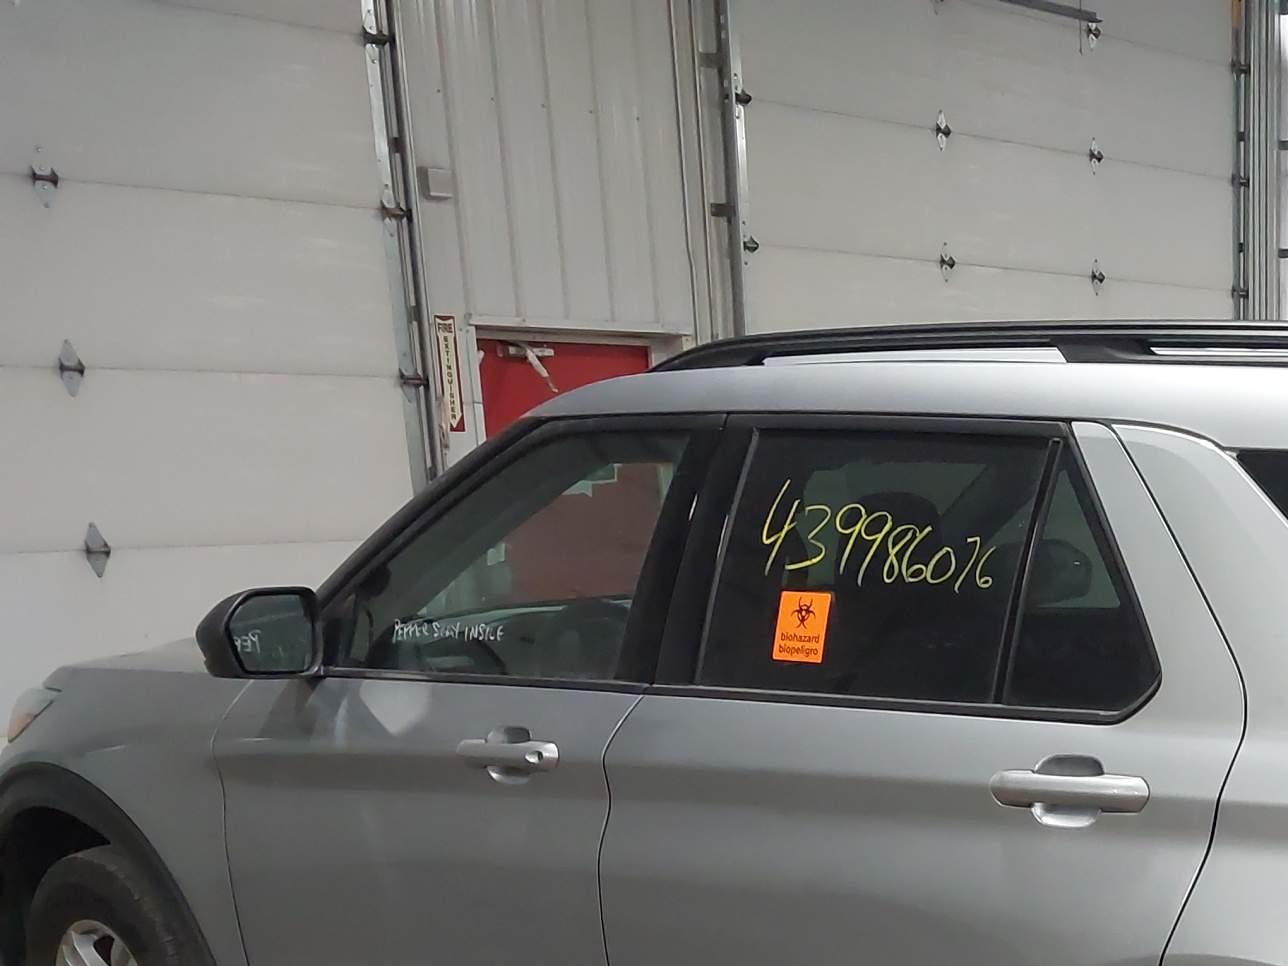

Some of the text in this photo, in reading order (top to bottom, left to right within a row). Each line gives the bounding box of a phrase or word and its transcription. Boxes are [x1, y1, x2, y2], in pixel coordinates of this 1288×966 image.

[437, 322, 453, 333] FIRE
[443, 336, 456, 420] EXTINGUISHER
[780, 632, 821, 644] biohazard
[778, 643, 819, 658] biopeligro
